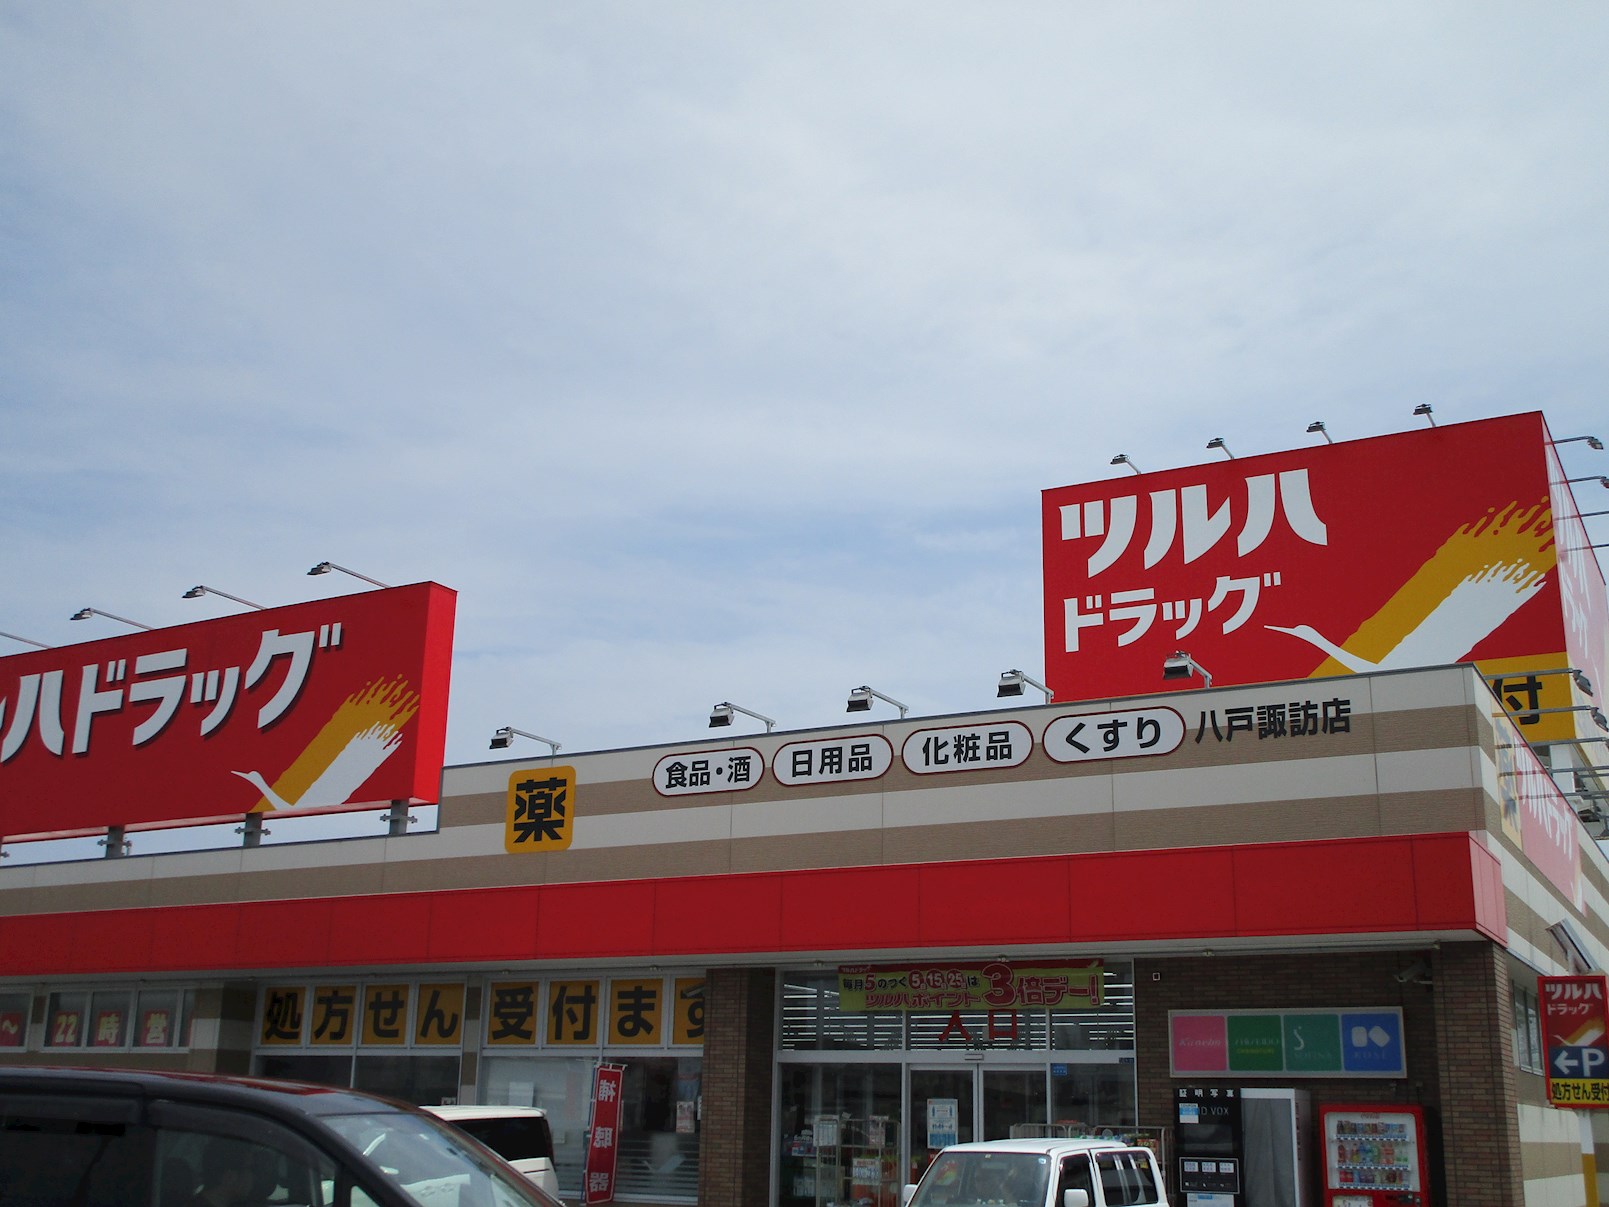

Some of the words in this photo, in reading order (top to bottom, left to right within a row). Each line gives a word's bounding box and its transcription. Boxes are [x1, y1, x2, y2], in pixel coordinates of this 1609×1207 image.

[1059, 468, 1328, 578] ツルハ
[1064, 571, 1281, 653] ドラッグ
[0, 622, 342, 764] ハドラッグ
[1065, 716, 1161, 754] くすり
[1195, 698, 1351, 744] 八戸諏訪店
[792, 743, 873, 777] 日用品
[922, 730, 1013, 767] 化粧品
[665, 756, 750, 789] 食品・酒
[513, 777, 567, 843] 薬
[1544, 983, 1603, 1000] ツルハ
[1547, 1003, 1594, 1016] ドラッグ
[1581, 1048, 1605, 1077] P
[1551, 1082, 1609, 1101] 処方せん受付
[1210, 1106, 1229, 1116] VOX
